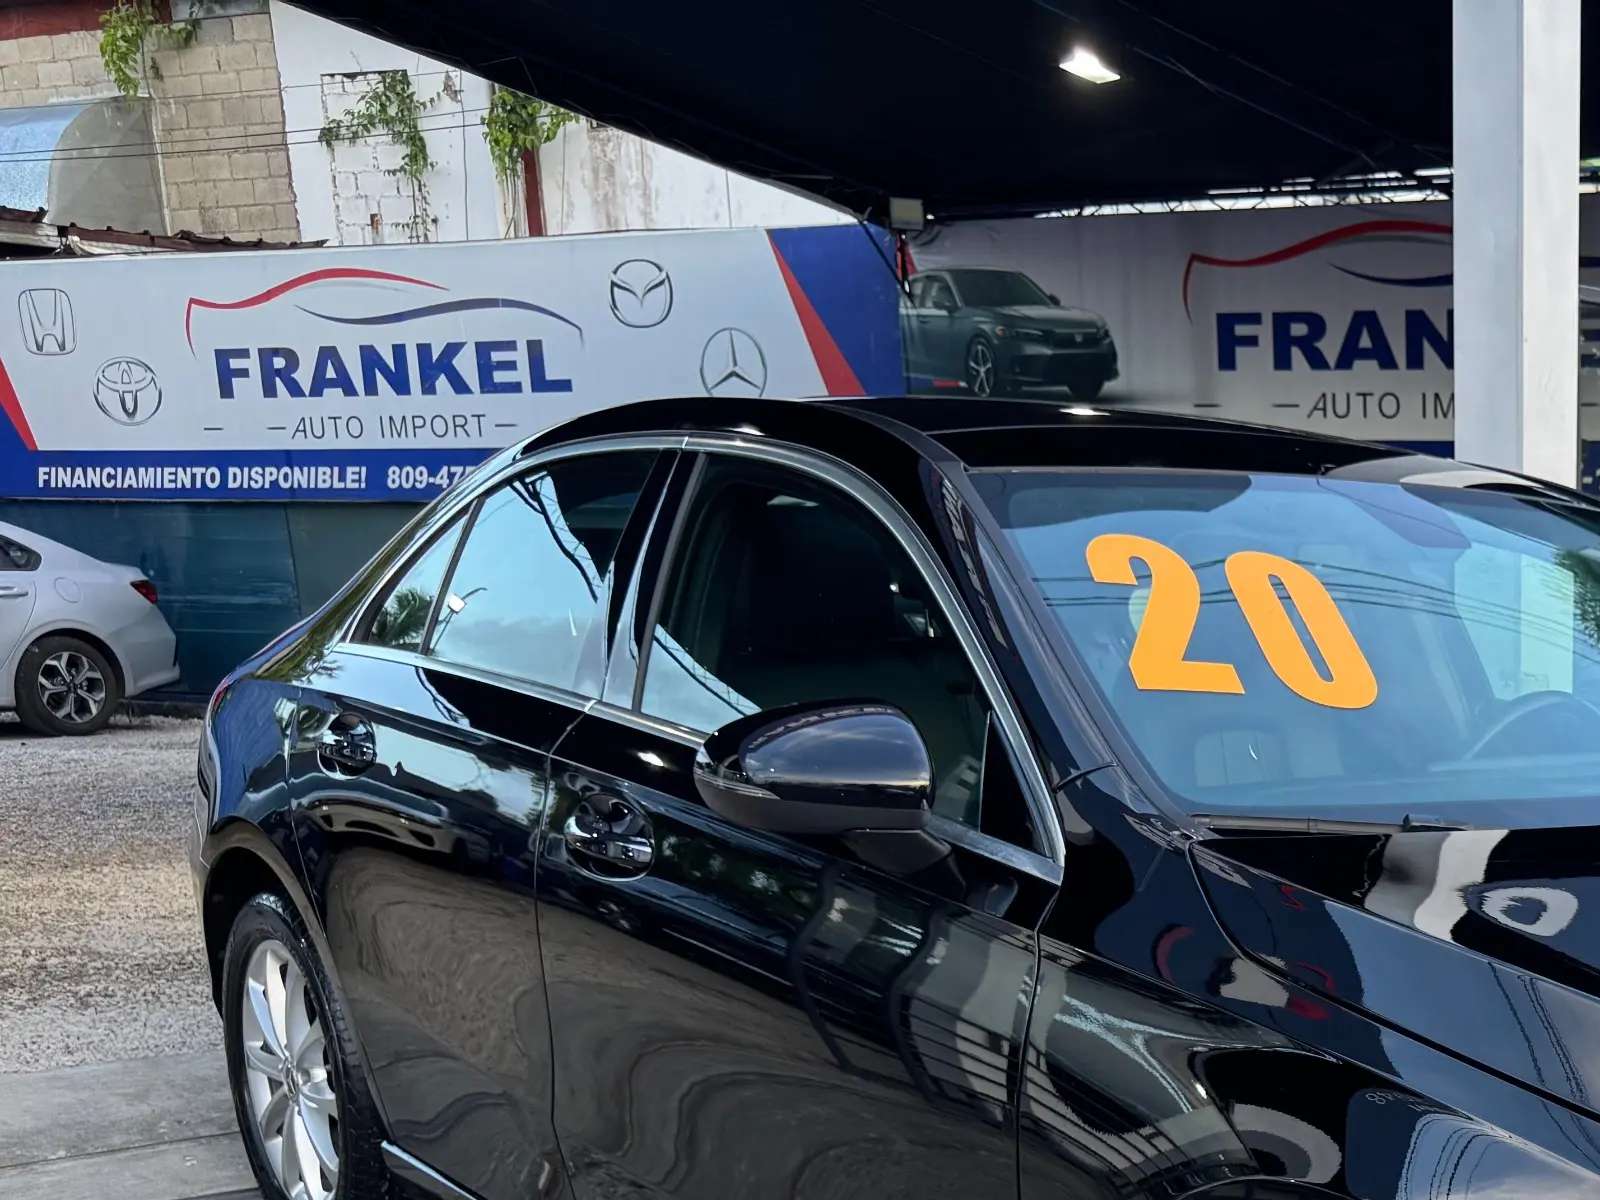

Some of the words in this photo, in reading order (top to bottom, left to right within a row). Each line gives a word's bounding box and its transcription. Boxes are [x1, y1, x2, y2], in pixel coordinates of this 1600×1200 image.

[214, 339, 573, 399] FRANKEL
[1307, 392, 1401, 420] AUTO
[290, 415, 365, 440] AUTO
[379, 413, 487, 439] IMPORT
[38, 465, 221, 490] FINANCIAMIENTO
[227, 465, 367, 489] DISPONIBLE!
[1086, 534, 1378, 709] 20
